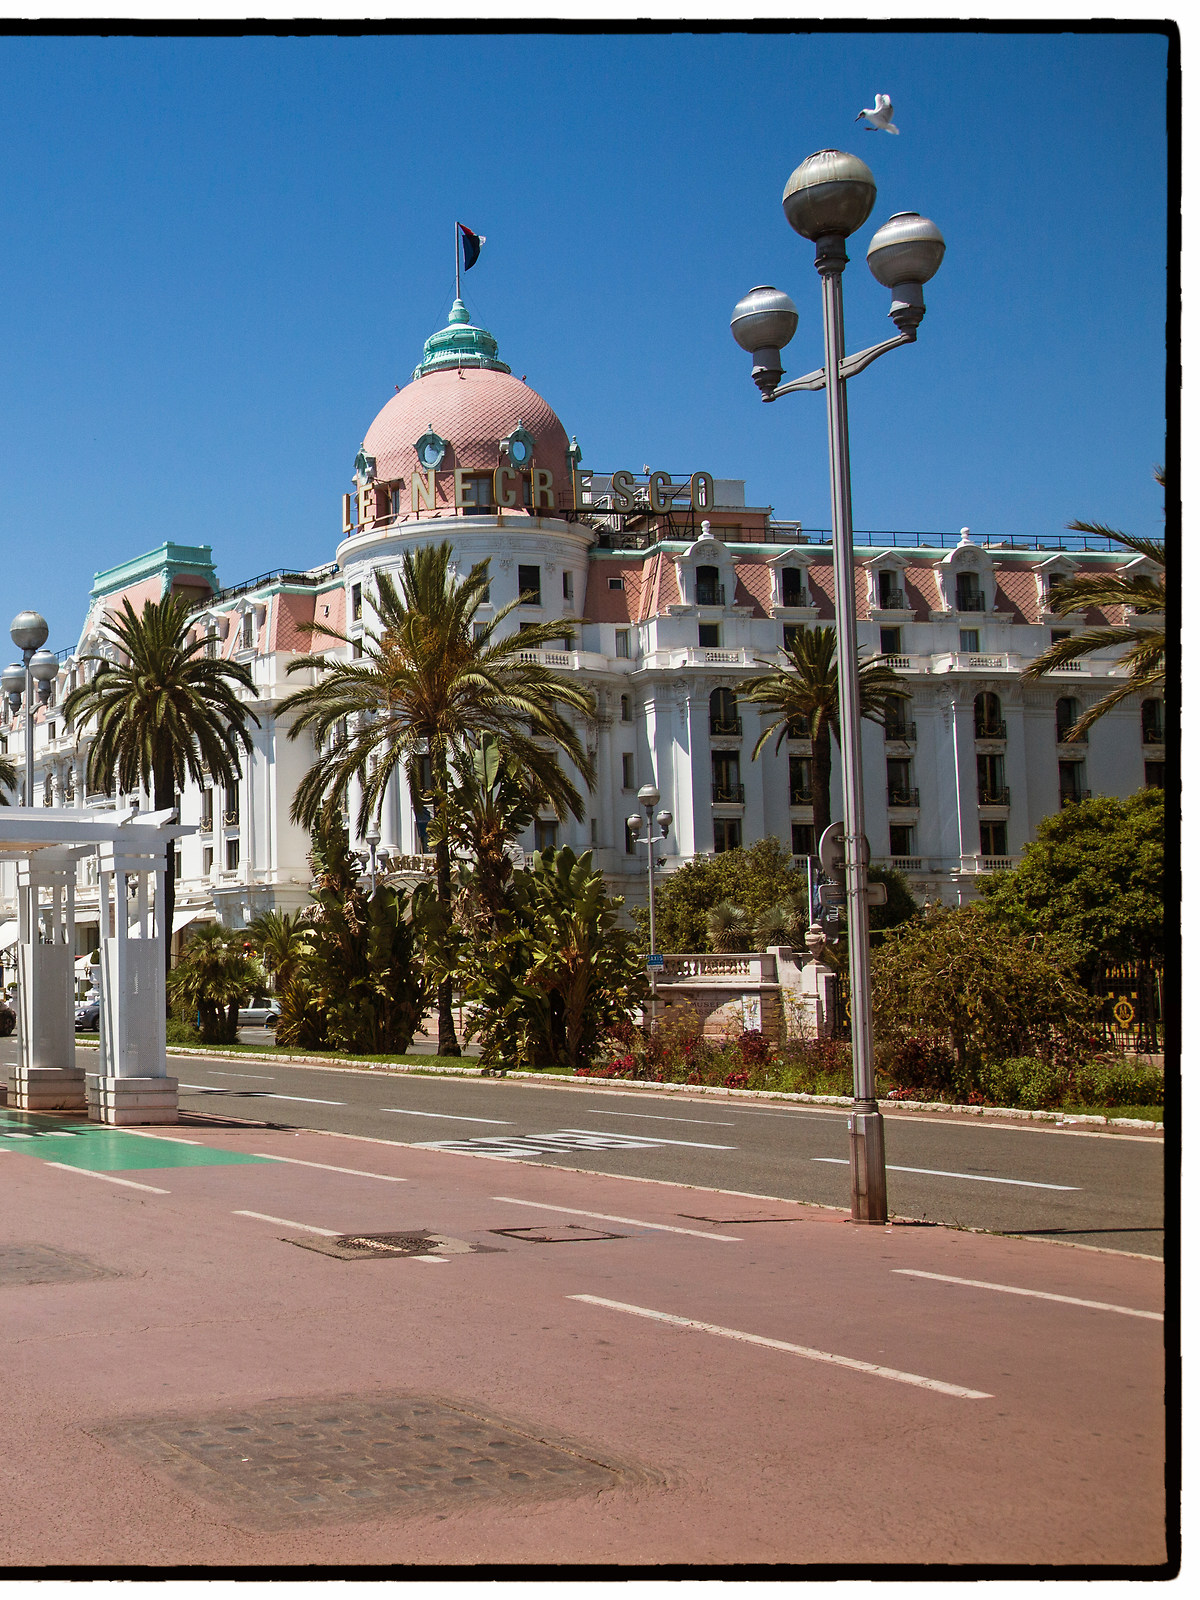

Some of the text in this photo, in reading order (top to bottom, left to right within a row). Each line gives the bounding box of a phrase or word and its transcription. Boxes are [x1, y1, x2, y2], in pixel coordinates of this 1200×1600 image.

[342, 466, 715, 533] LE NEGRESCO
[408, 1133, 666, 1157] BUS
